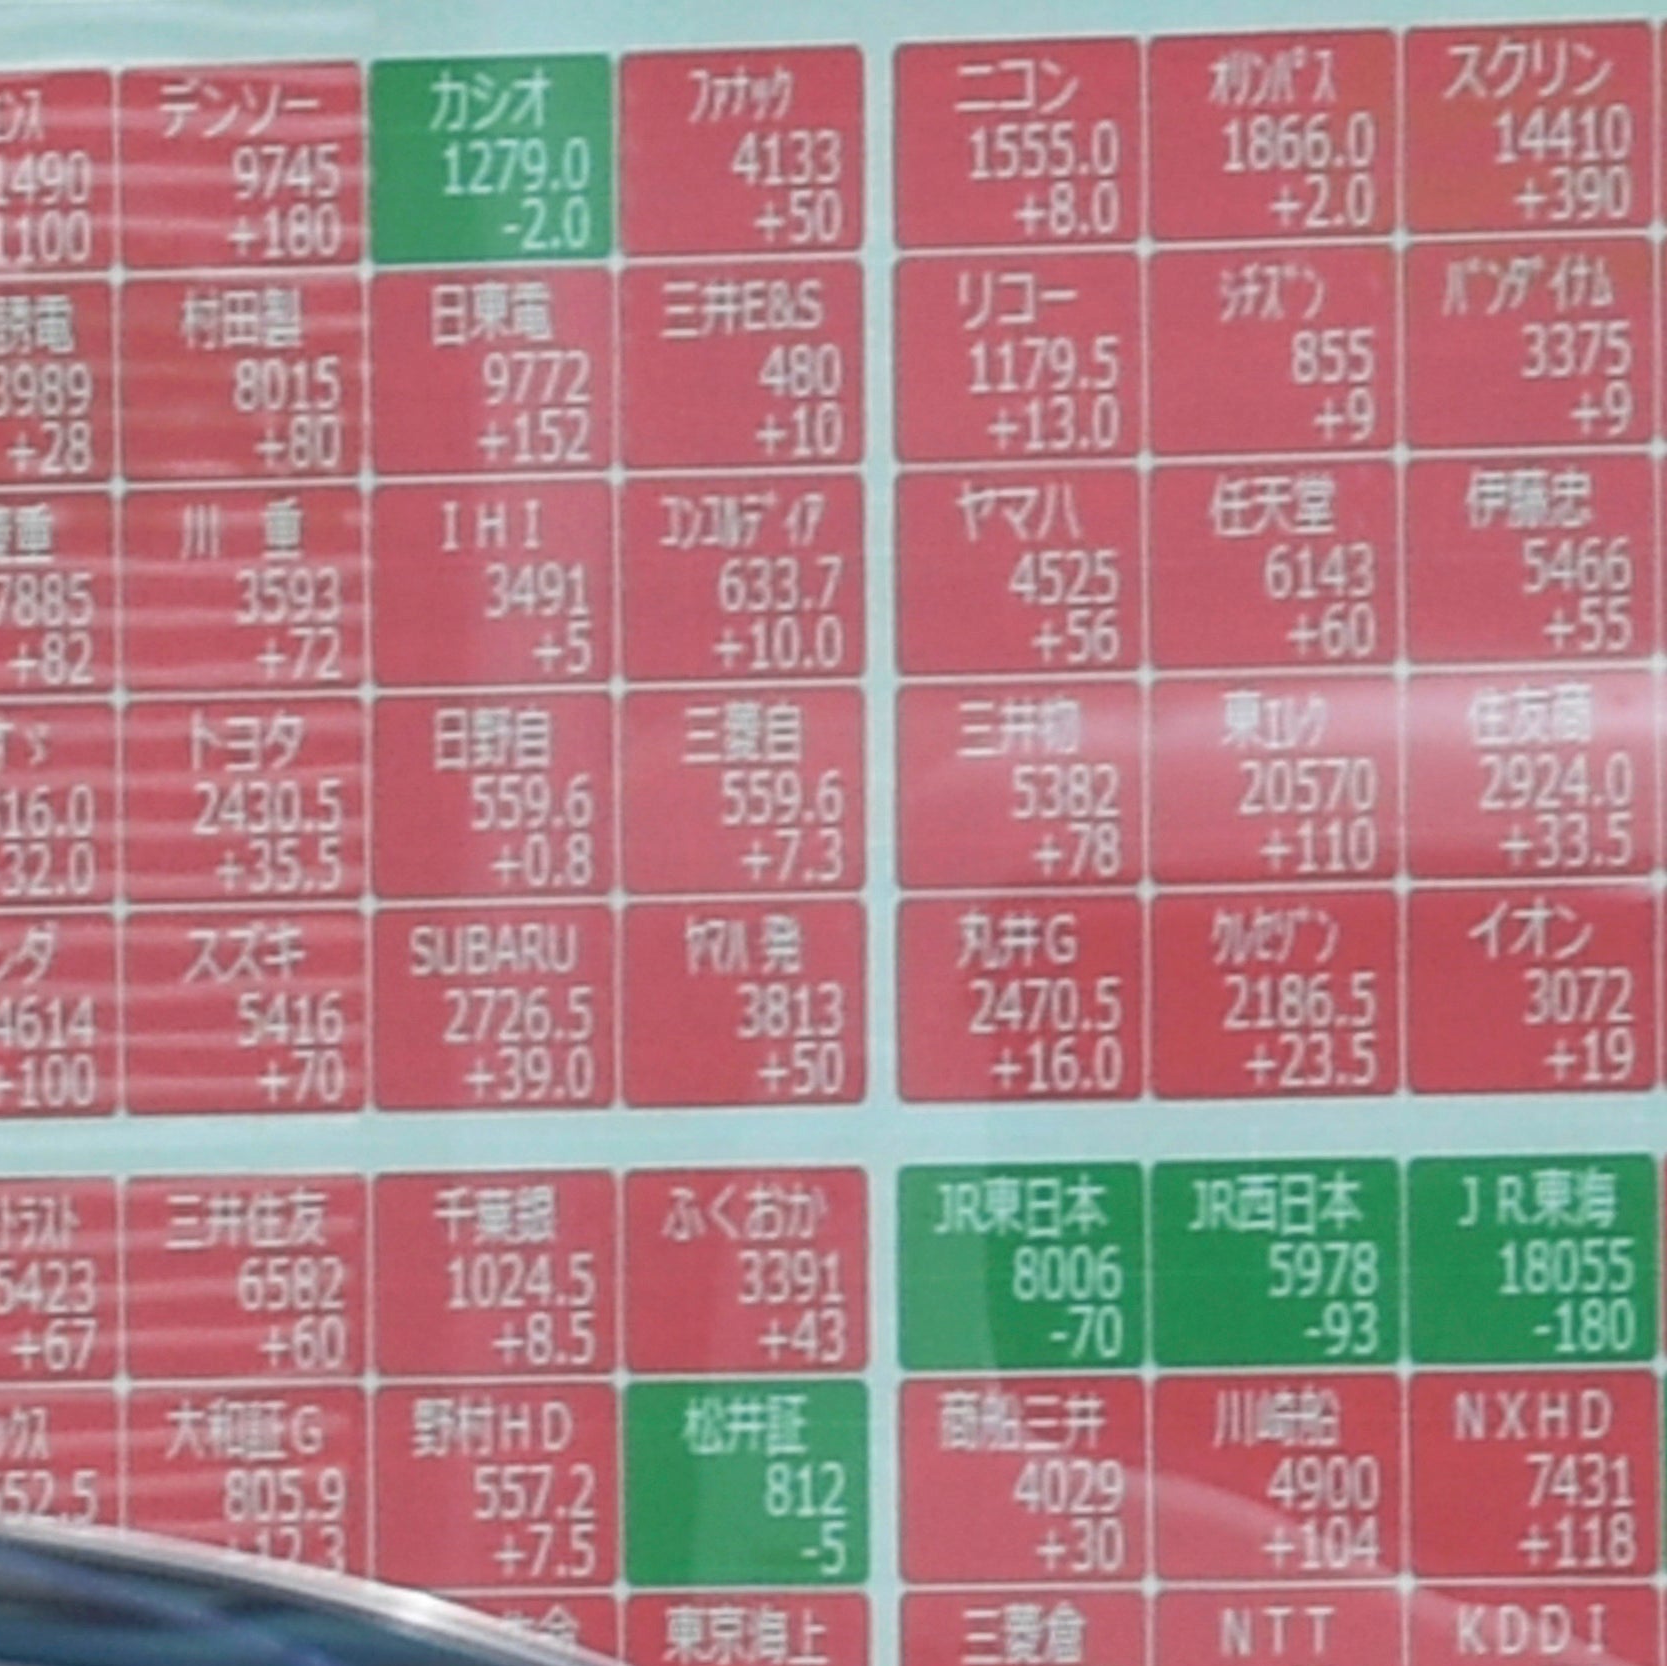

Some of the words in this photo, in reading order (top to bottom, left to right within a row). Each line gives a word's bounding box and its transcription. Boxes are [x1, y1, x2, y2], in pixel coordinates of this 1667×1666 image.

[953, 56, 1081, 114] ニコン
[1443, 39, 1614, 99] スクリン
[160, 80, 322, 138] デンソー
[429, 67, 553, 132] カシオ
[731, 129, 843, 186] 4133
[968, 120, 1119, 180] 1555.0
[1222, 112, 1376, 174] 1866.0
[1493, 104, 1633, 166] 14410
[441, 138, 591, 195] 1279.0
[1516, 166, 1633, 222] +390
[502, 198, 591, 250] -2.0
[958, 271, 1078, 330] リコー
[759, 345, 843, 397] 480
[968, 336, 1119, 394] 1179.5
[1291, 329, 1376, 385] 855
[1521, 321, 1633, 378] 3375
[483, 351, 591, 406] 9772
[956, 482, 1081, 541] ヤマハ
[1209, 474, 1336, 538] 任天堂
[484, 563, 592, 618] 3491
[718, 558, 843, 613] 633.7
[1009, 551, 1119, 606] 4525
[1266, 544, 1375, 599] 6143
[1522, 537, 1633, 594] 5466
[532, 621, 592, 674] +5
[1288, 604, 1375, 658] +60
[1544, 598, 1633, 652] +55
[189, 709, 306, 772] トヨタ
[193, 779, 342, 835] 2430.5
[471, 776, 593, 830] 559.6
[720, 771, 843, 826] 559.6
[1011, 765, 1120, 821] 5382
[1238, 759, 1377, 816] 20570
[1479, 754, 1633, 809] 2924.0
[1259, 820, 1377, 873] +110
[183, 921, 307, 983] スズキ
[410, 925, 578, 976] SUBARU
[956, 912, 1078, 969] 丸井G
[1468, 900, 1594, 960] イオン
[444, 988, 594, 1043] 2726.5
[736, 984, 844, 1039] 3813
[969, 978, 1122, 1034] 2470.5
[1223, 972, 1377, 1030] 2186.5
[1523, 968, 1633, 1024] 3072
[464, 1046, 594, 1101] +39.0
[991, 1036, 1122, 1092] +16.0
[1545, 1028, 1635, 1082] +19
[663, 1184, 828, 1241] ふくおか
[935, 1177, 1108, 1238] JR東日本
[1189, 1174, 1364, 1234] JR西日本
[447, 1253, 596, 1308] 1024.5
[736, 1251, 845, 1305] 3391
[1012, 1244, 1123, 1300] 8006
[1268, 1241, 1379, 1299] 5978
[1498, 1238, 1635, 1295] 18055
[1048, 1305, 1123, 1359] -70
[1303, 1301, 1379, 1356] -93
[1533, 1299, 1635, 1354] -180
[1455, 1390, 1613, 1442] NXHD
[223, 1467, 346, 1523] 805.9
[473, 1463, 596, 1520] 557.2
[766, 1462, 846, 1518] 812
[1014, 1459, 1125, 1514] 4029
[1267, 1455, 1379, 1510] 4900
[1525, 1454, 1635, 1507] 7431
[493, 1524, 596, 1578] +7.5
[801, 1522, 846, 1576] -5
[1263, 1516, 1379, 1570] +104
[1221, 1607, 1335, 1656] NTT
[1458, 1604, 1606, 1654] KDDI
